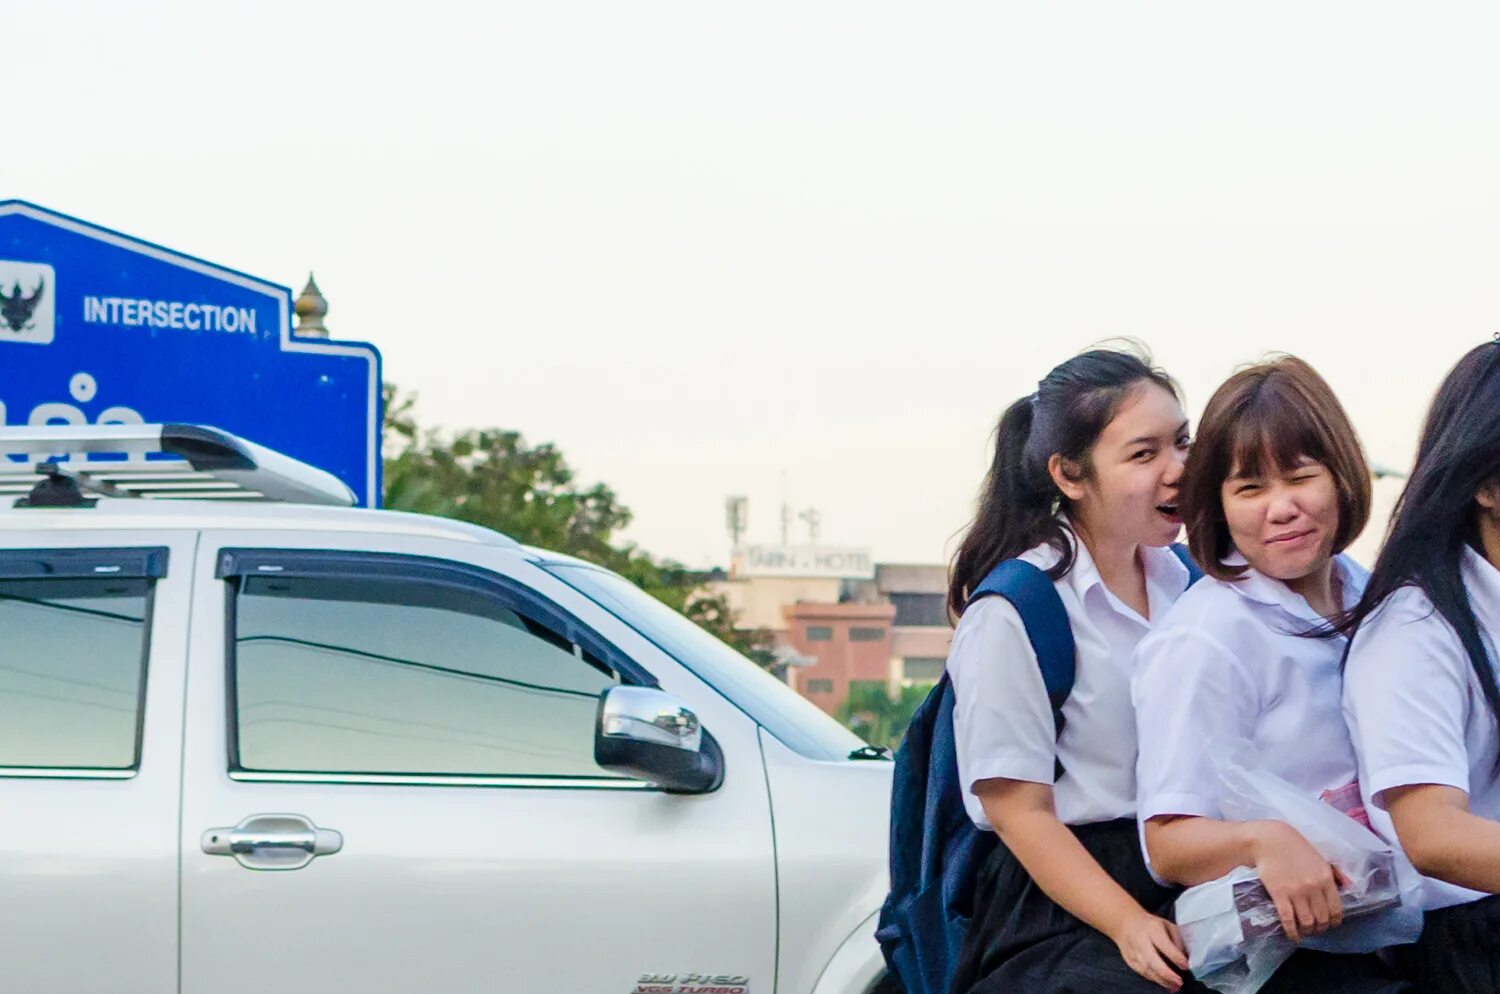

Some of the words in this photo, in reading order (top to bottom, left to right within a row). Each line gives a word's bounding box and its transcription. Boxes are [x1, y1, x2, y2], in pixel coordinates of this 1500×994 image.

[84, 296, 256, 333] INTERSECTION
[637, 985, 673, 994] VGS
[677, 986, 744, 994] TURBO
